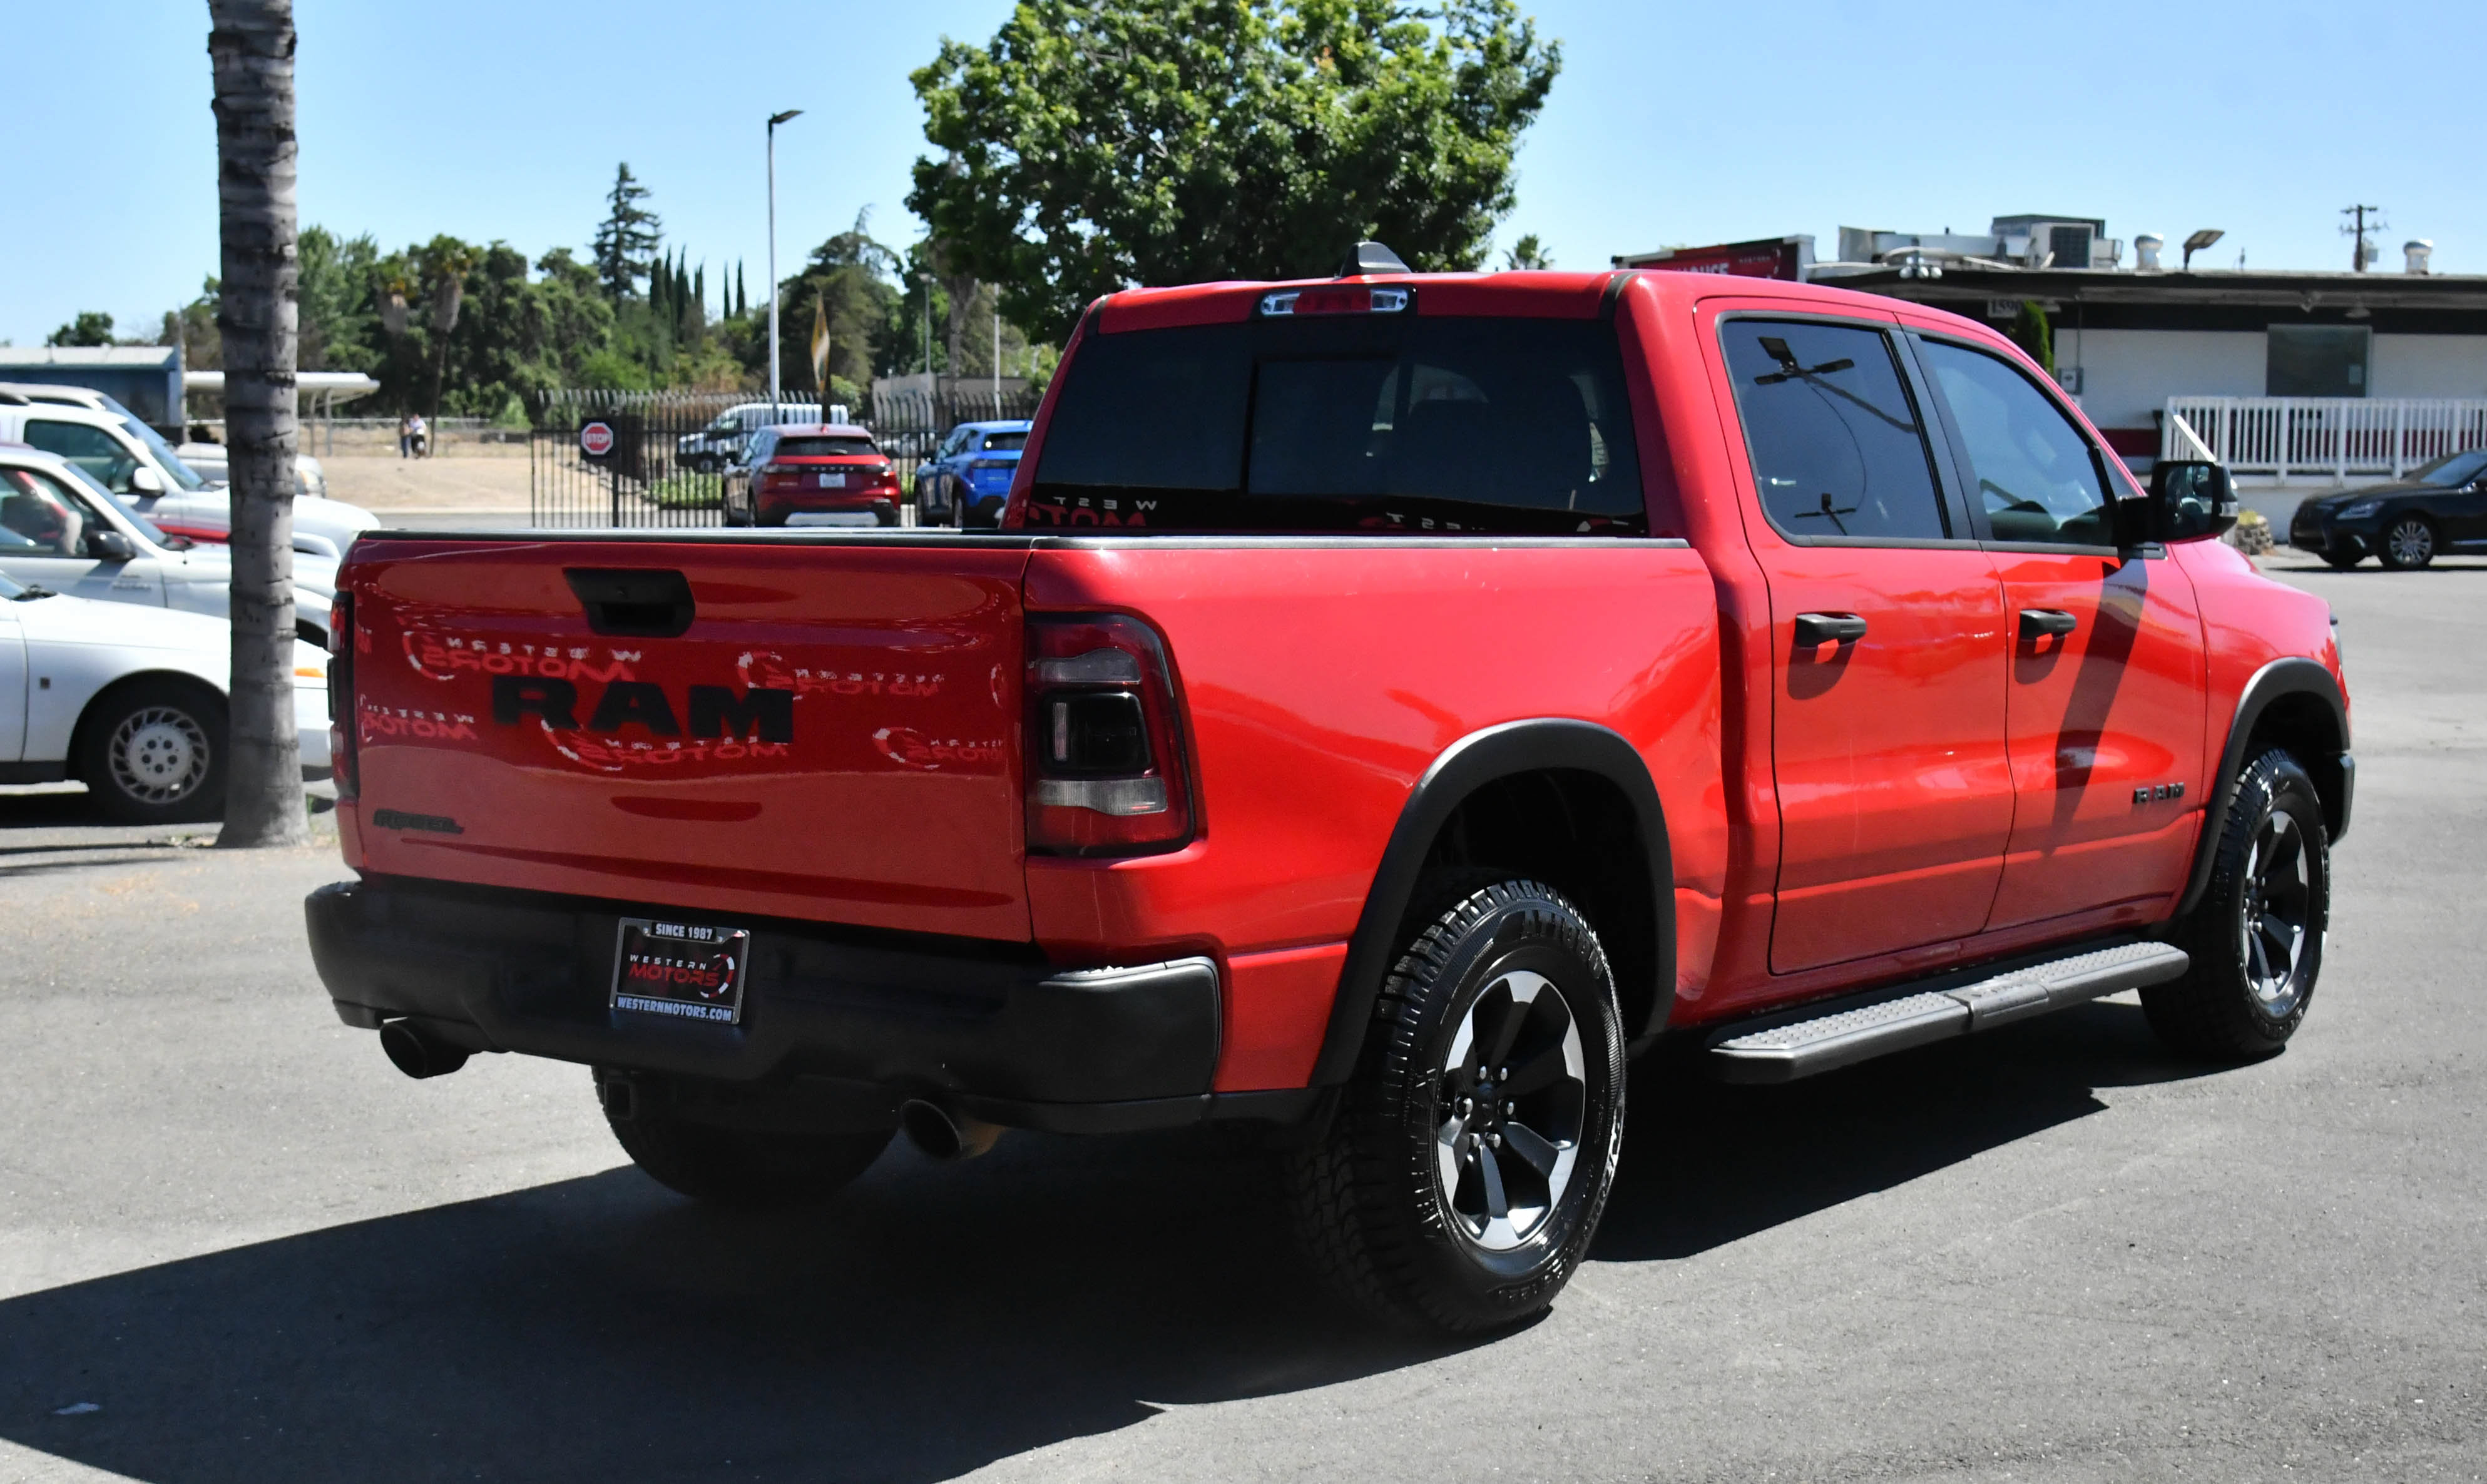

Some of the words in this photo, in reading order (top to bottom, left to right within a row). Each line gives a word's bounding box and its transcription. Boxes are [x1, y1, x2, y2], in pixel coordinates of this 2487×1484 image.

[492, 674, 793, 744] RAM
[2133, 782, 2185, 804] RAM
[655, 923, 685, 938] SINCE
[688, 926, 713, 940] 1987
[629, 953, 707, 970] WESTERN
[628, 963, 720, 987] MOTORS
[616, 996, 733, 1022] WESTERNMOTORS.COM
